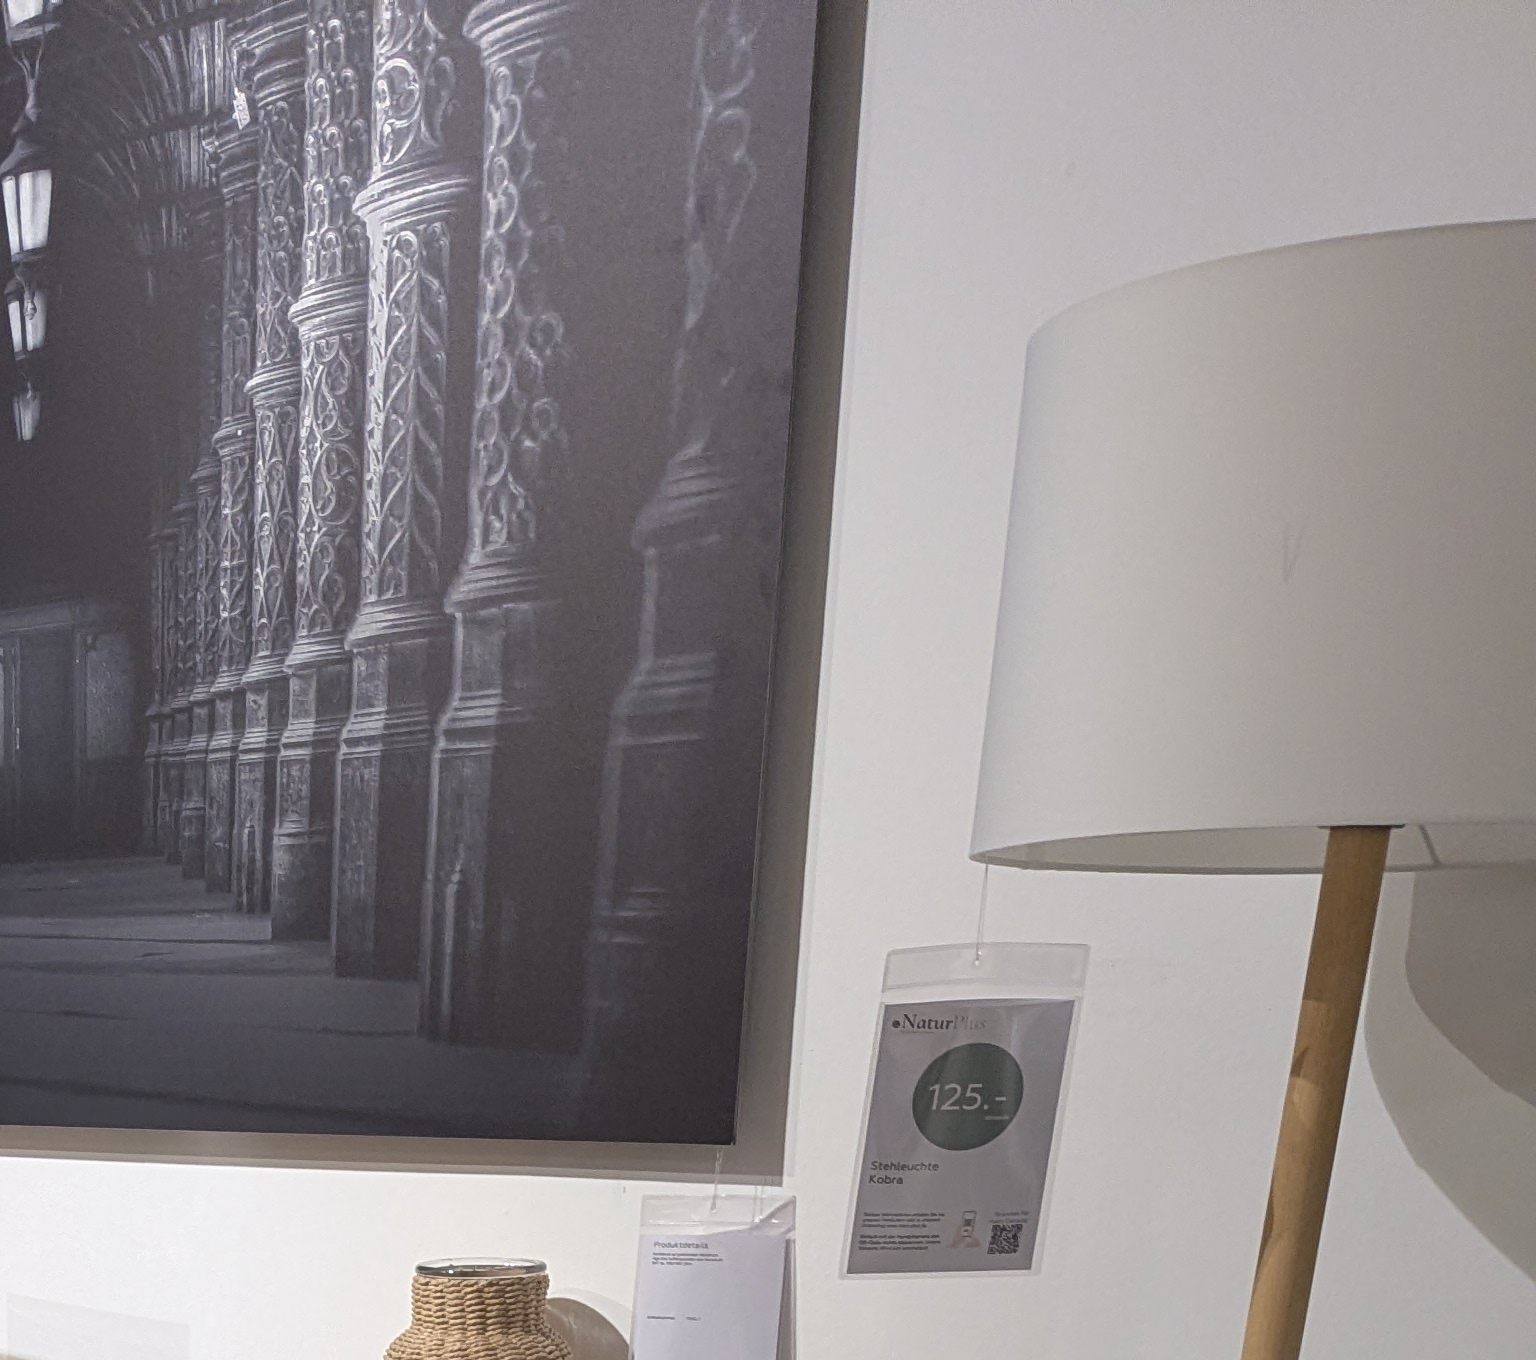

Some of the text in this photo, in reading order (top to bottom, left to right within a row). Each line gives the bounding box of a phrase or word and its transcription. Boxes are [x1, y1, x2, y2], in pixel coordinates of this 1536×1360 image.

[929, 1083, 1006, 1110] 125.-
[870, 1160, 940, 1172] Stehleuchte
[868, 1175, 904, 1184] Kobra
